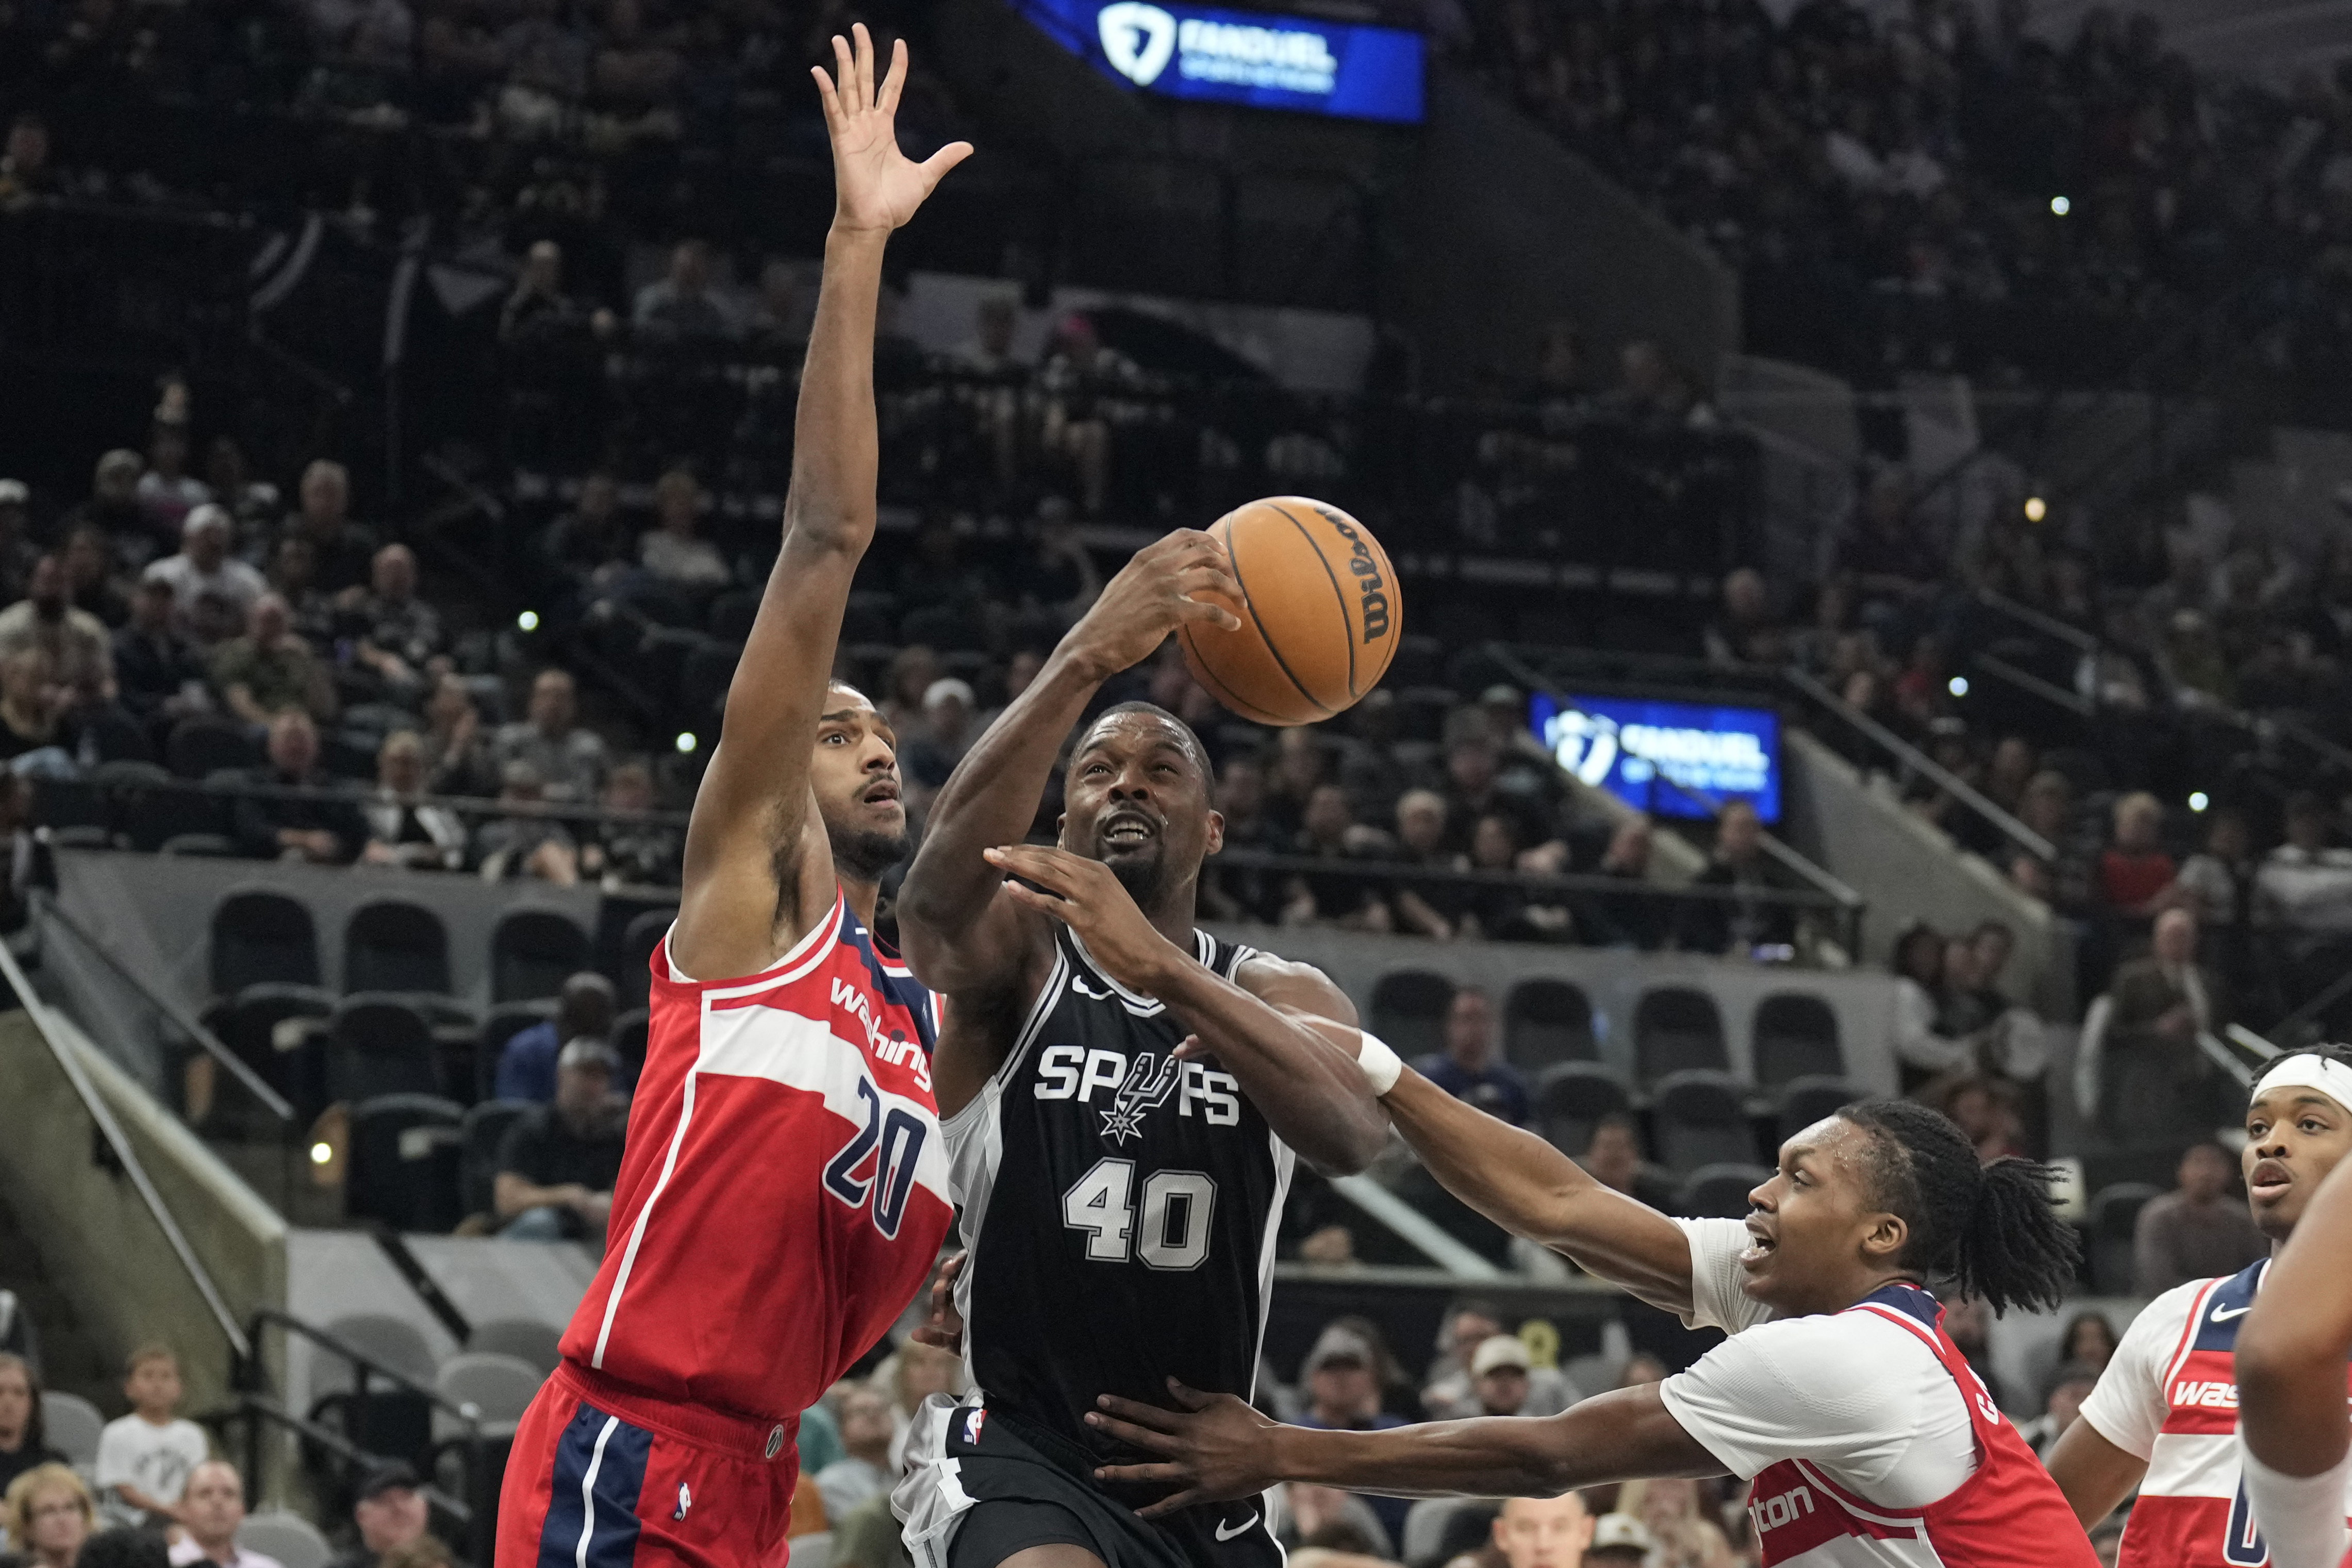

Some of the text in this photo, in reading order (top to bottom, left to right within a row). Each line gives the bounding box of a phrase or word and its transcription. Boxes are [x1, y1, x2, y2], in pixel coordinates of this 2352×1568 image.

[1313, 507, 1389, 644] Wilson
[1033, 1045, 1240, 1137] SPURS
[823, 1074, 927, 1241] 20
[1062, 1157, 1218, 1272] 40
